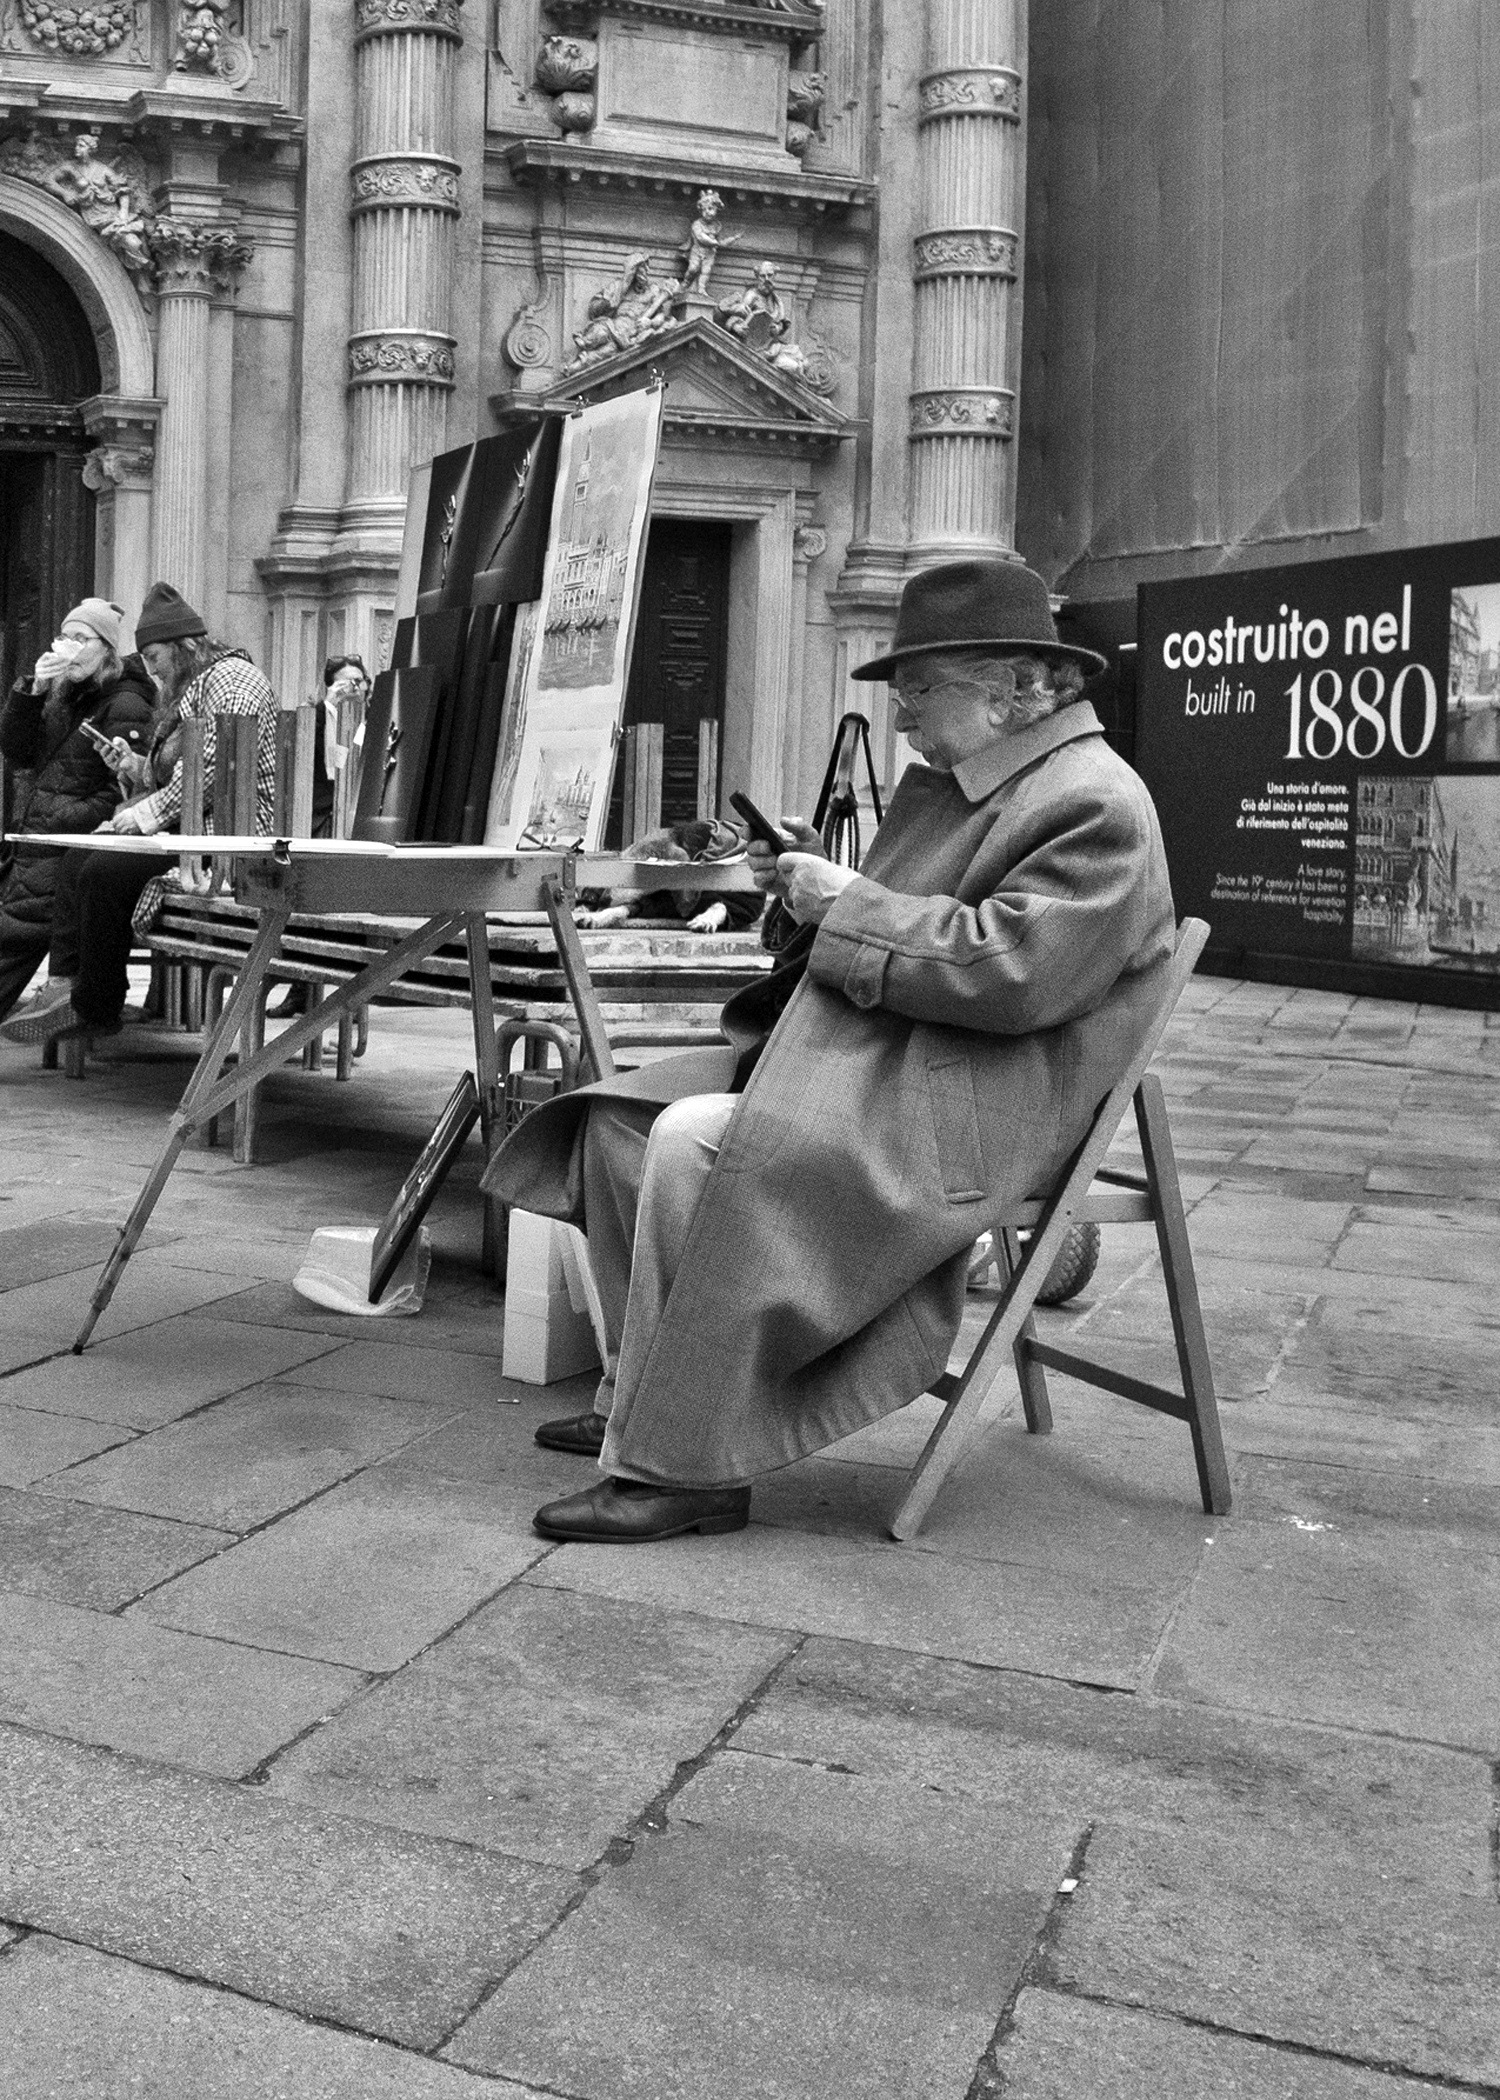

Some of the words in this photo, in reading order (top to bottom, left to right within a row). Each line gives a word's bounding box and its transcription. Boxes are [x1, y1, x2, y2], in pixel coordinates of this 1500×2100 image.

[1163, 604, 1329, 669] costruito
[1345, 584, 1412, 655] nel
[1185, 677, 1231, 716] built
[1237, 682, 1255, 713] in
[1283, 663, 1437, 760] 1880
[1267, 782, 1284, 794] Una
[1286, 783, 1309, 795] storia
[1311, 781, 1349, 795] d'amore.
[1241, 799, 1256, 811] Già
[1258, 799, 1271, 811] dal
[1273, 800, 1295, 812] inizio
[1305, 801, 1325, 812] stato
[1327, 802, 1349, 812] meta
[1236, 815, 1245, 829] di
[1246, 815, 1289, 829] riferimento
[1291, 817, 1348, 833] dell'ospitalità
[1301, 837, 1347, 849] veneziana.
[1297, 864, 1305, 875] A
[1307, 865, 1323, 876] love
[1216, 873, 1236, 885] Since
[1237, 874, 1248, 886] the
[1265, 878, 1294, 891] century
[1302, 880, 1315, 891] has
[1317, 880, 1338, 892] been
[1211, 888, 1250, 901] destination
[1261, 891, 1297, 904] reference
[1299, 893, 1310, 905] for
